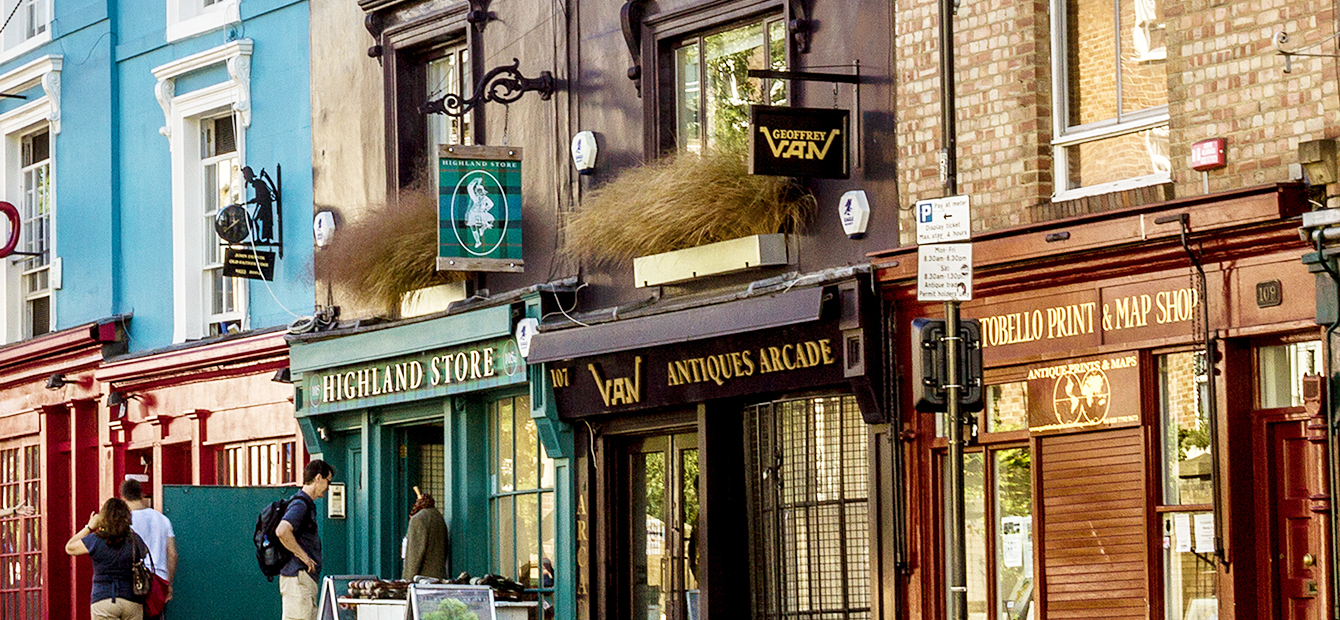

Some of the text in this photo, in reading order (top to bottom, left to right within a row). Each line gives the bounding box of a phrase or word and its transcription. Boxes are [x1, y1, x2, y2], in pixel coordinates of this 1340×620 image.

[759, 126, 840, 160] VAN
[773, 129, 827, 141] GEOFFREY
[922, 205, 931, 222] P
[925, 224, 944, 232] Display
[1259, 286, 1277, 302] 109
[979, 288, 1198, 348] TOBELLO PRINT & MAP SHOP
[322, 360, 423, 403] HIGHLAND
[430, 347, 496, 387] STORE
[550, 338, 835, 407] 107 VAN ANTIQUES ARCADE
[1027, 356, 1138, 380] ANTIQUE PRINTS & MAPS
